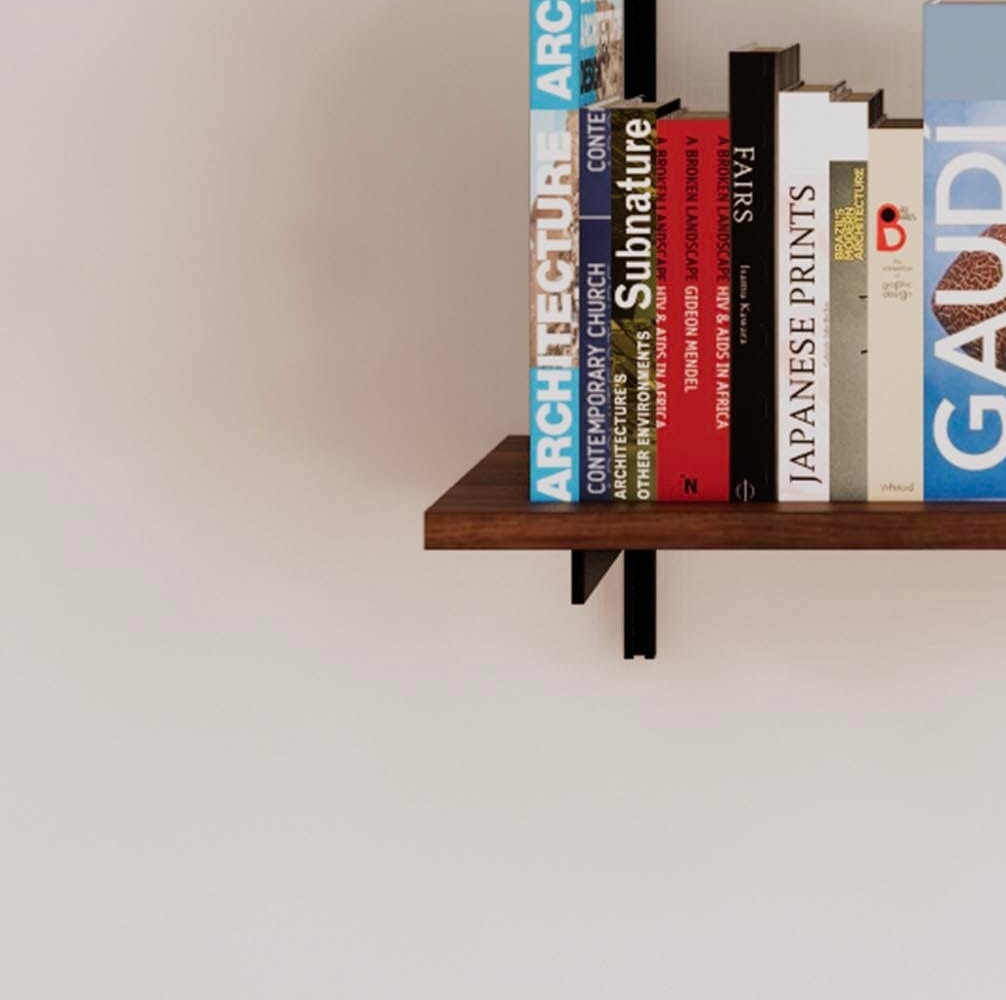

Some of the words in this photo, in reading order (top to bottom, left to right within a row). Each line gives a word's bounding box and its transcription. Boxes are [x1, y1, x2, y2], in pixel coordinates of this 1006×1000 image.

[685, 137, 698, 146] A
[716, 137, 729, 146] A
[685, 149, 698, 203] BROKEN
[716, 149, 729, 203] BROKEN
[733, 146, 755, 223] FAIRS
[613, 118, 652, 310] Subnature
[685, 206, 698, 282] LANDSCAPE
[716, 206, 729, 282] LANDSCAPE
[789, 185, 815, 305] PRINTS
[853, 167, 865, 261] ARCHITECTURE
[536, 130, 574, 501] ARCHITECTURE
[587, 263, 606, 339] CHURCH
[685, 286, 699, 336] GIDEON
[716, 286, 730, 311] HIV
[739, 303, 751, 344] Kawara
[685, 340, 699, 393] MENDEL
[716, 327, 730, 359] AIDS
[716, 362, 730, 378] IN
[587, 344, 606, 494] CONTEMPORARY
[637, 330, 651, 446] ENVIRONMENTS
[716, 381, 730, 429] AFRICA
[789, 317, 822, 484] JAPANESE
[614, 373, 628, 500] ARCHITECTURE'S
[637, 450, 651, 500] OTHER
